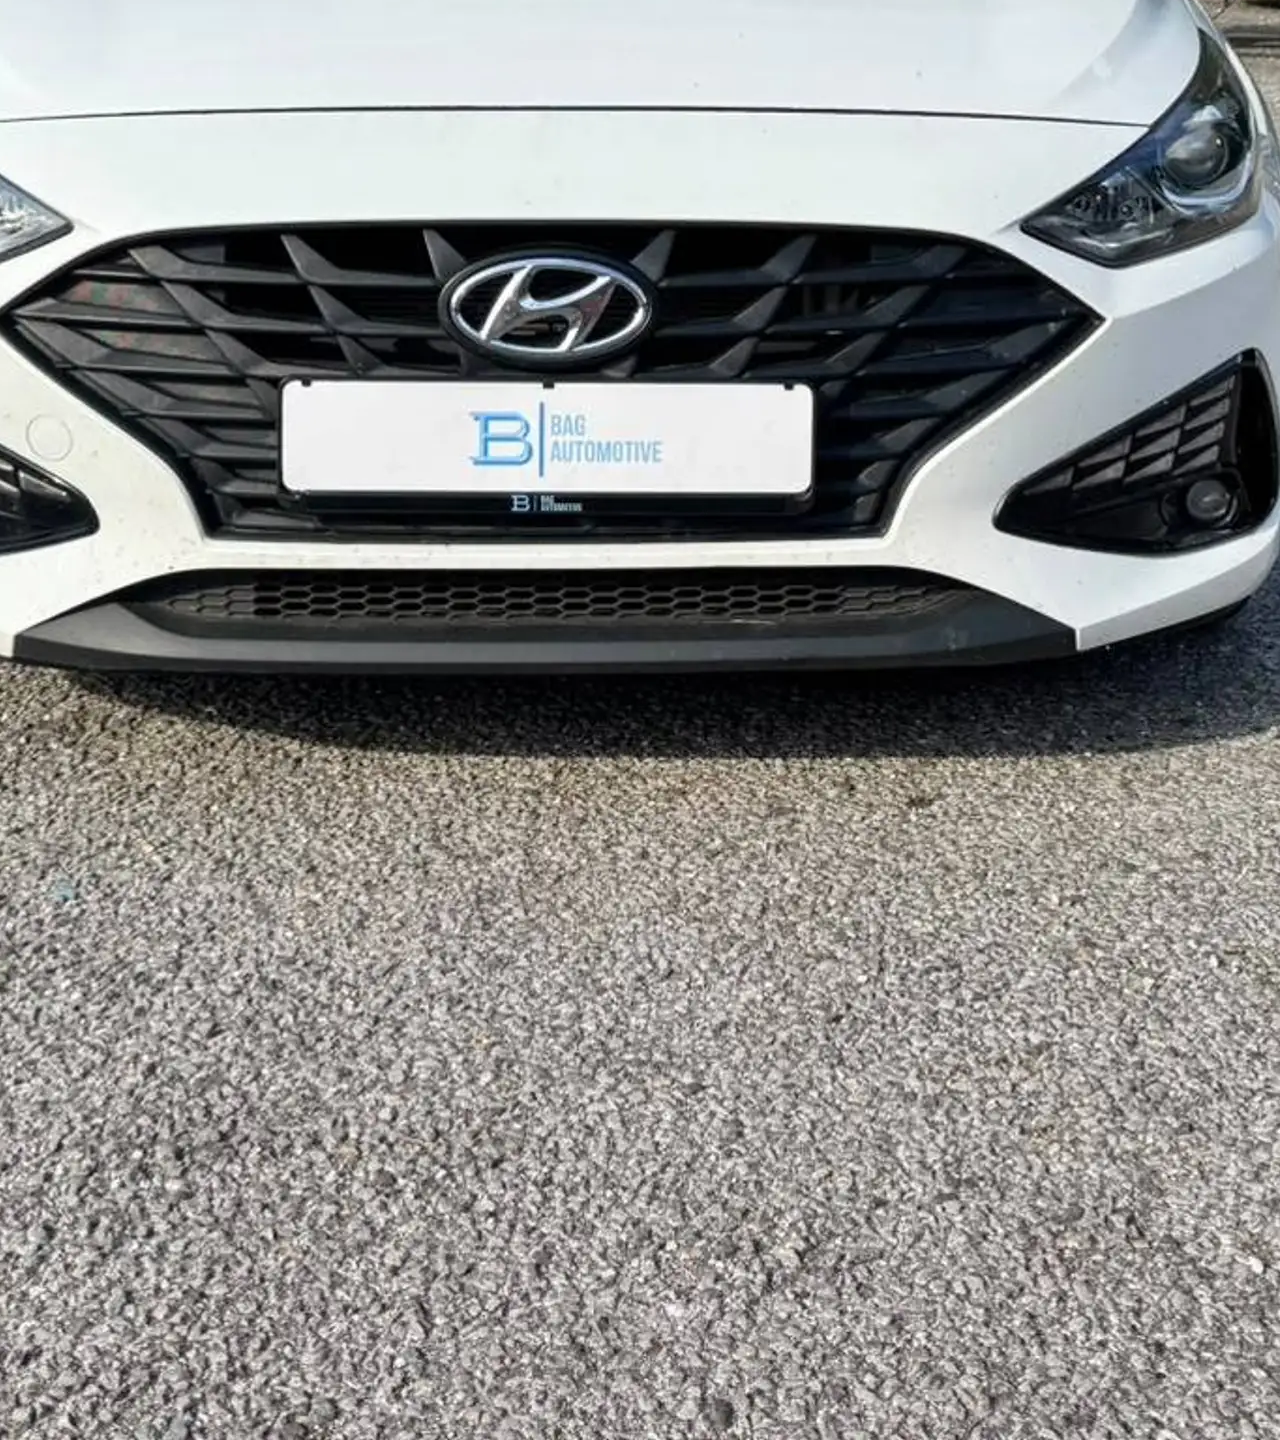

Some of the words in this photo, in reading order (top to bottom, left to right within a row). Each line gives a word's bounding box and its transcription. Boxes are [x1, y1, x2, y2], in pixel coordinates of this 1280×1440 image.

[550, 414, 586, 436] BAG
[470, 411, 533, 466] B
[550, 441, 662, 462] AUTOMOTIVE
